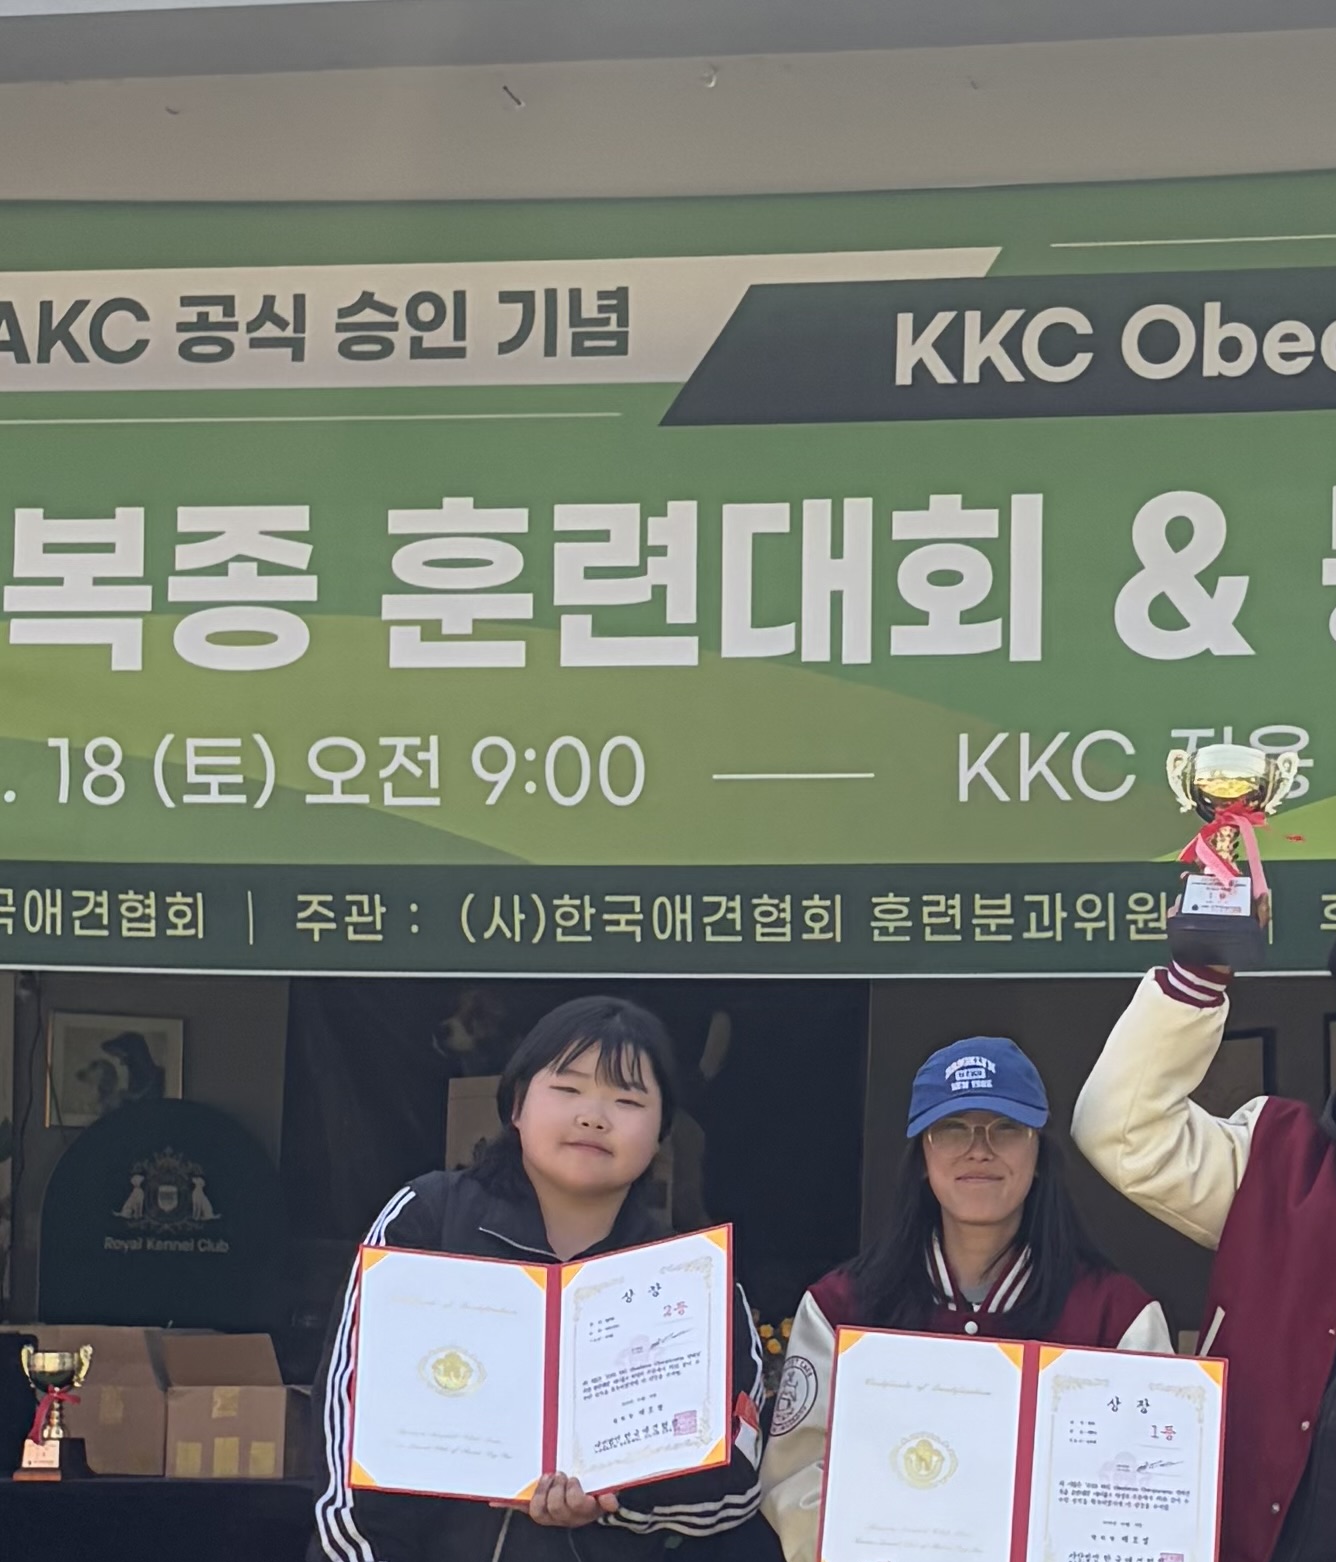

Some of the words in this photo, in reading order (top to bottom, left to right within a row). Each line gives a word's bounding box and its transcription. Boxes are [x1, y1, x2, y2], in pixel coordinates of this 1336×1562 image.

[175, 292, 308, 362] 공식
[334, 289, 468, 361] 승인
[496, 285, 630, 358] 기념
[895, 307, 1094, 386] KKC
[3, 505, 319, 672] 복종
[380, 493, 1044, 669] 훈련대회
[1113, 490, 1257, 662] &
[46, 737, 126, 805] 18
[152, 732, 277, 809] (토)
[304, 734, 443, 807] 오전
[470, 734, 647, 807] 9:00
[955, 730, 1137, 803] KKC
[296, 893, 387, 943] 주관
[460, 891, 843, 945] (사)한국애견협회
[870, 887, 1169, 943] 훈련분과위원
